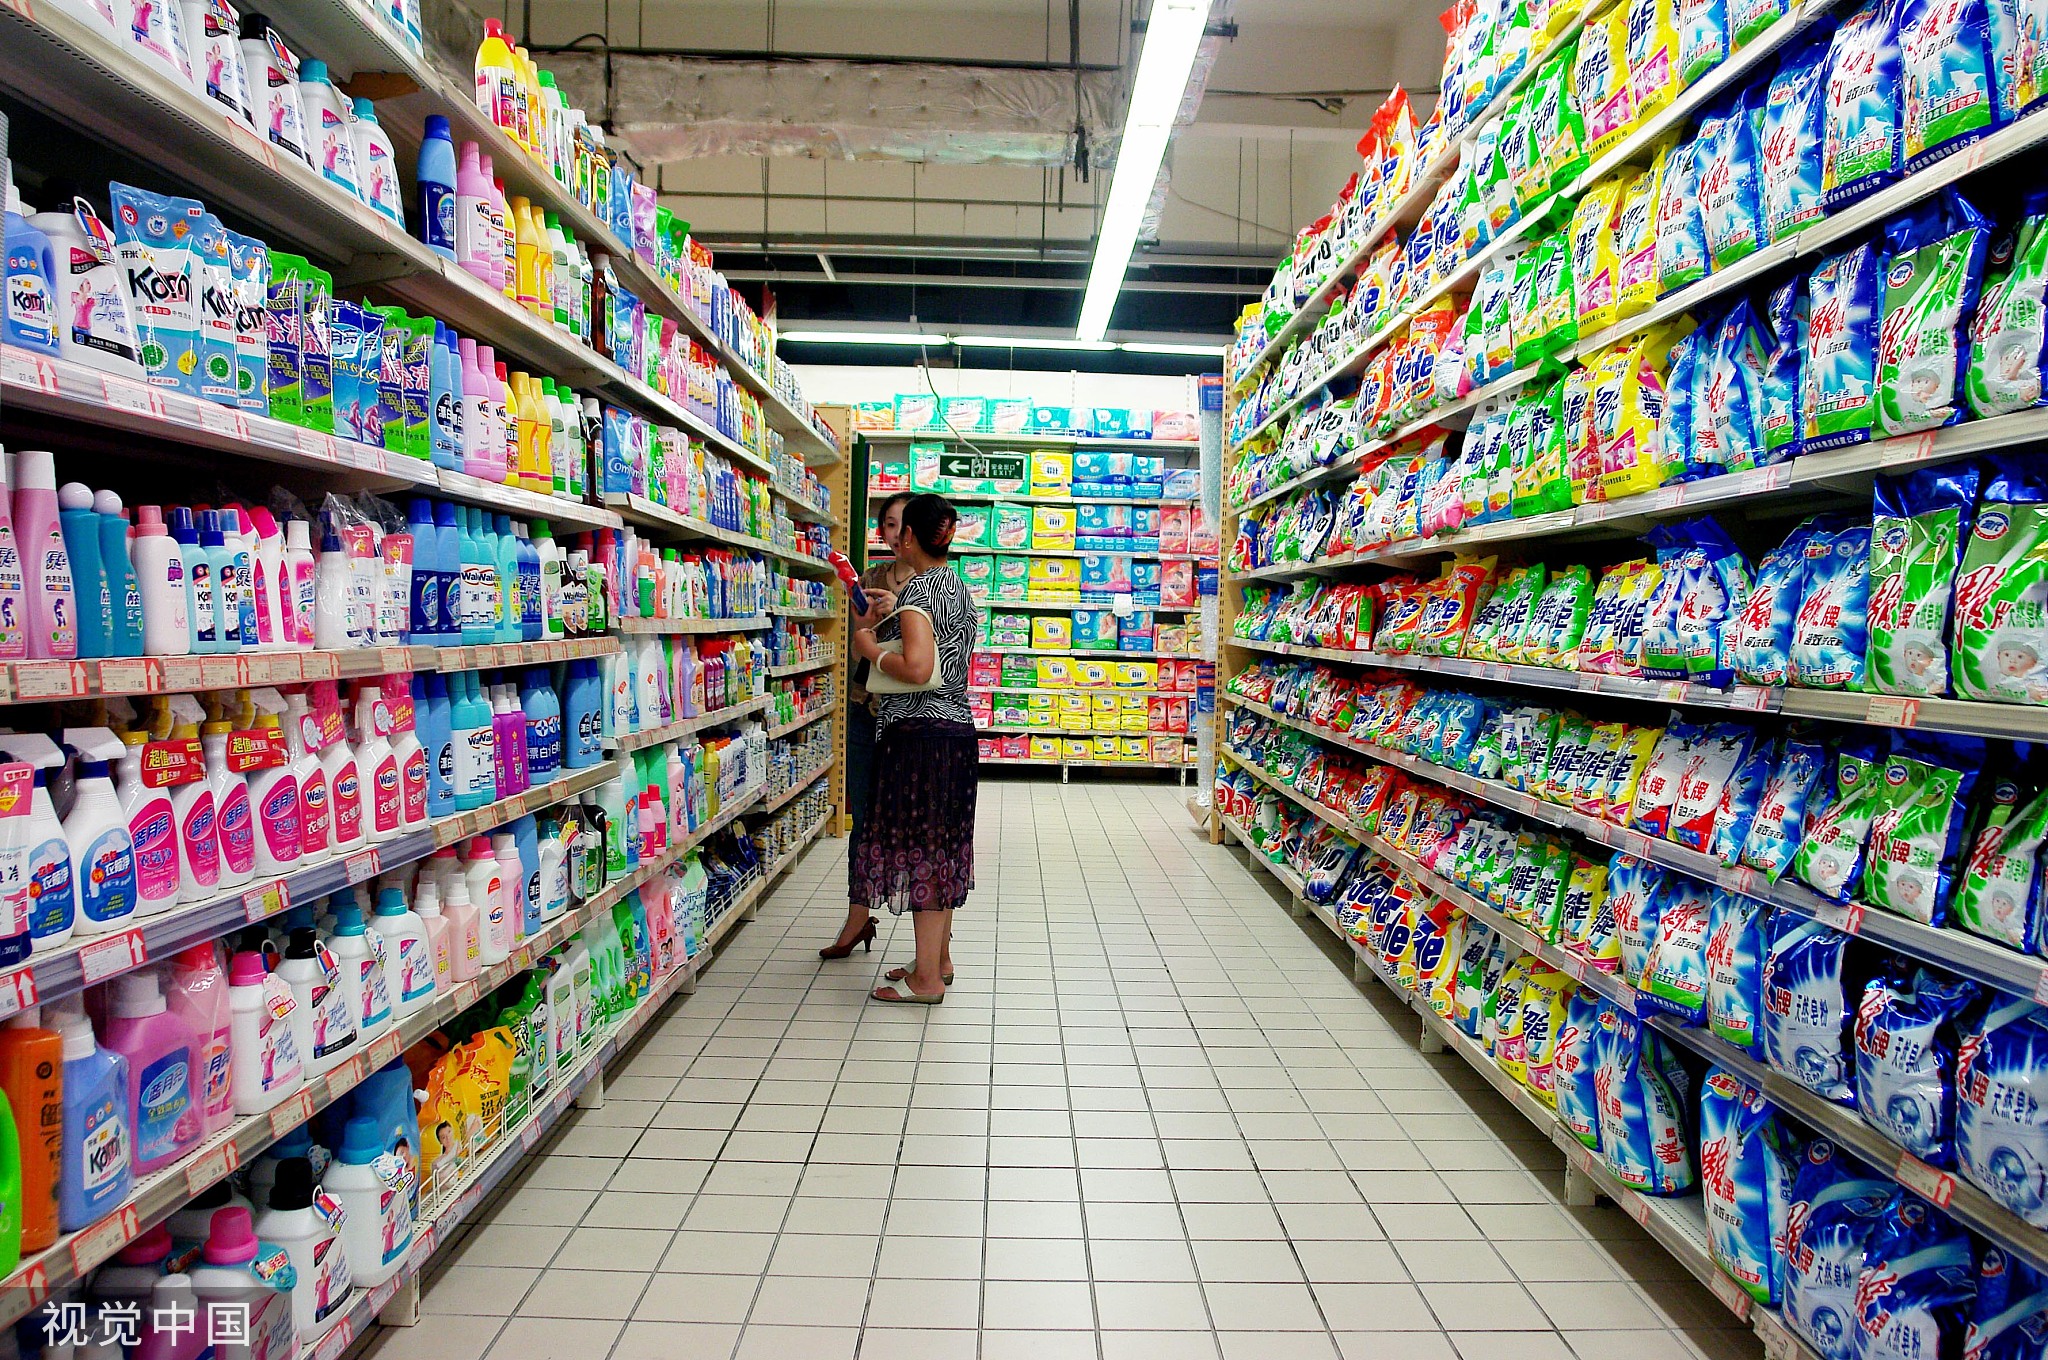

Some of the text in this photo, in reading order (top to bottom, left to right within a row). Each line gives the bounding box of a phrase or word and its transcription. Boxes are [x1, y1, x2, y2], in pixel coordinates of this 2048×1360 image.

[1794, 993, 1829, 1029] 天然皂粉
[1990, 1081, 2039, 1126] 天然皂粉
[1815, 1256, 1851, 1290] 天然皂粉
